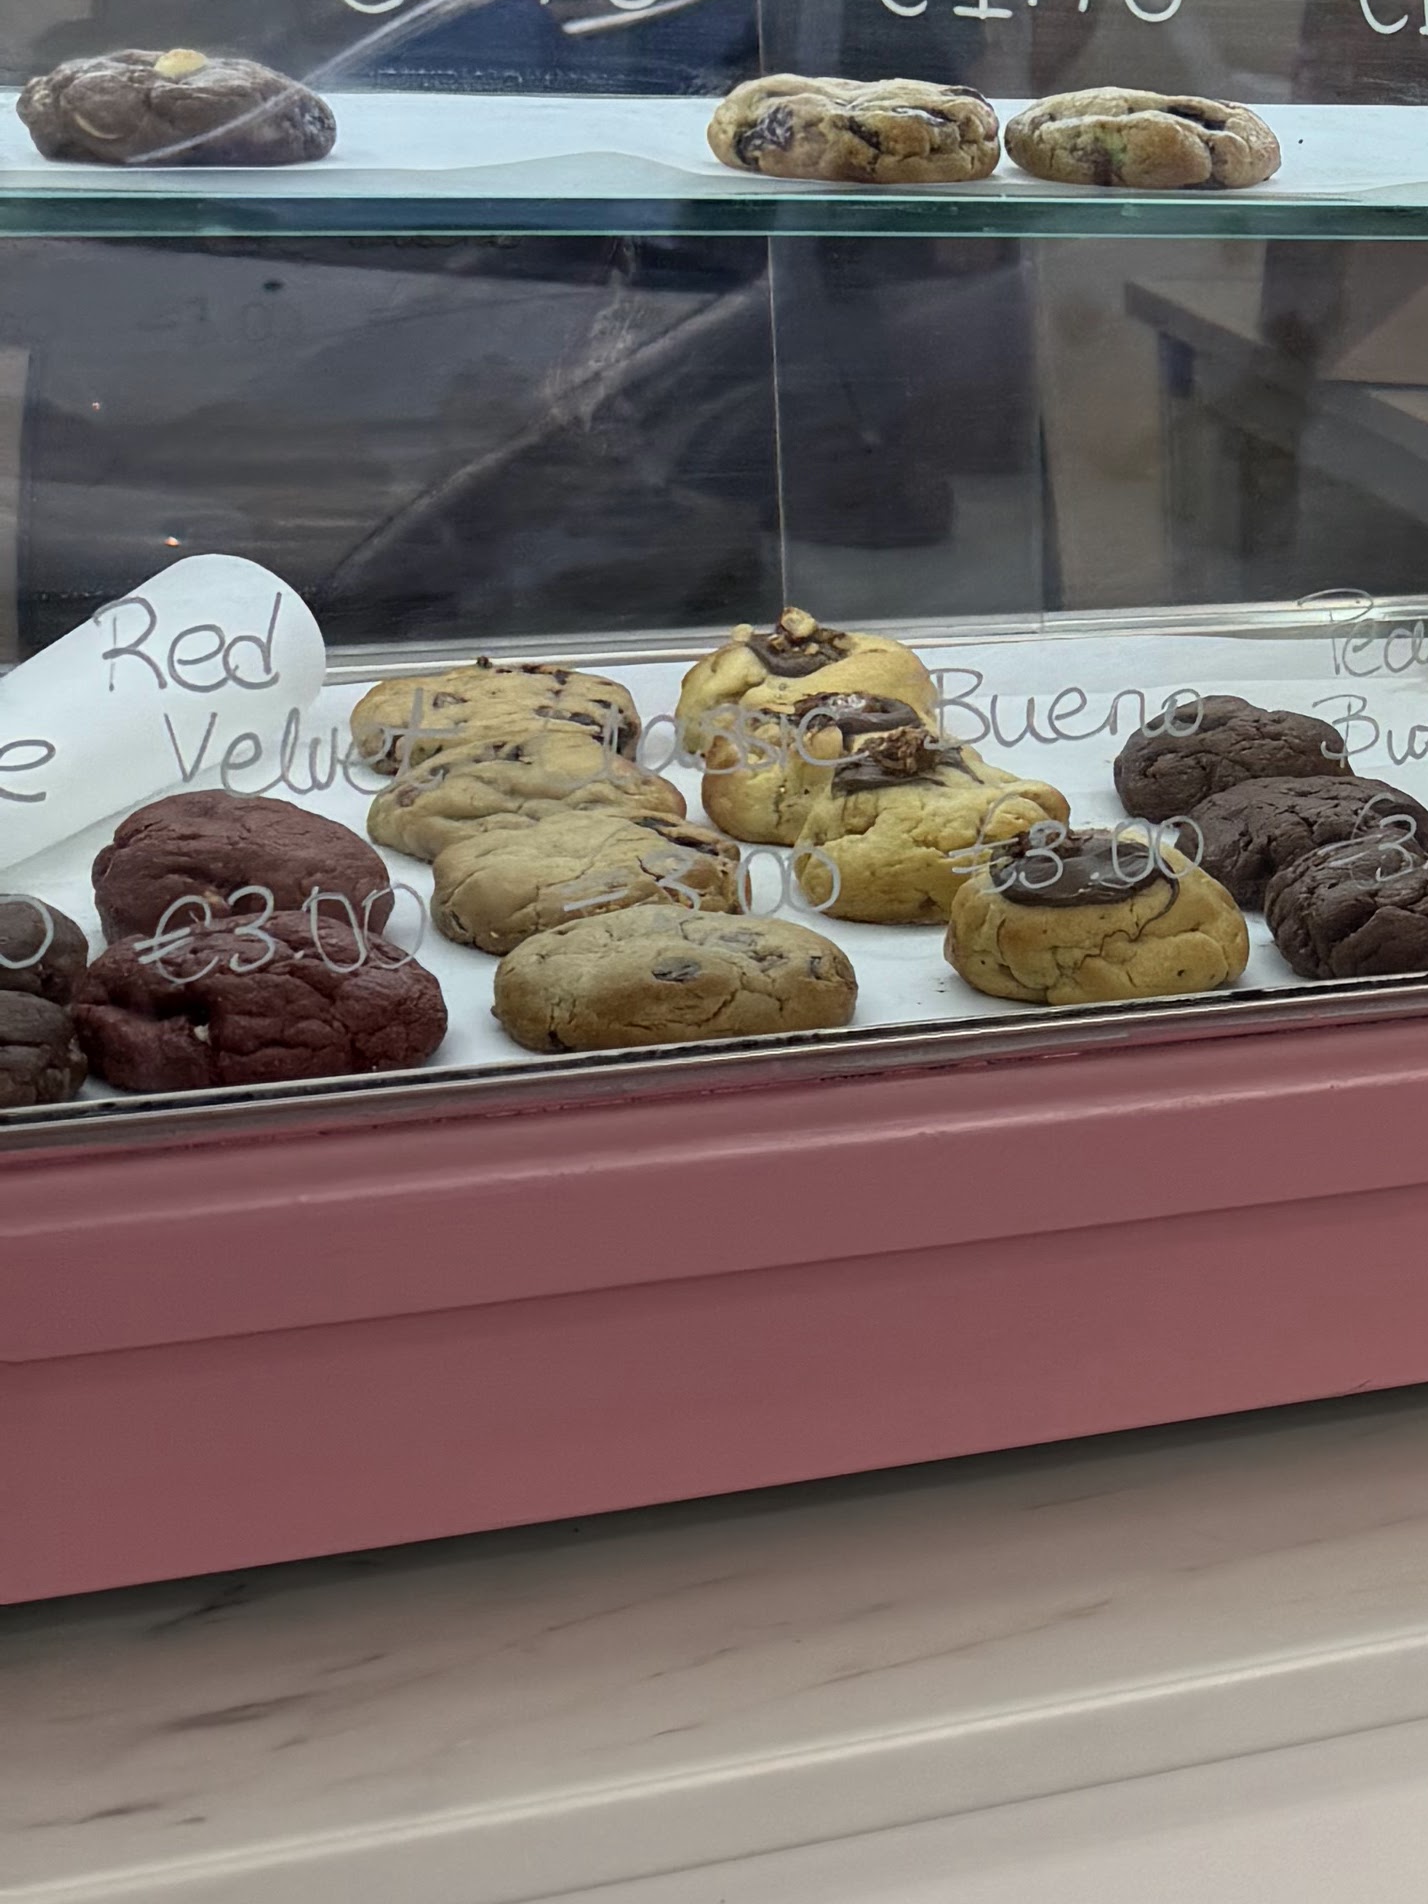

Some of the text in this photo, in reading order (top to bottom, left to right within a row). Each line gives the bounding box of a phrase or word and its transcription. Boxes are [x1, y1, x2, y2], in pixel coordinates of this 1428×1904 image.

[93, 592, 282, 693] Red
[924, 666, 1205, 751] Bueno
[134, 881, 427, 986] €3.00
